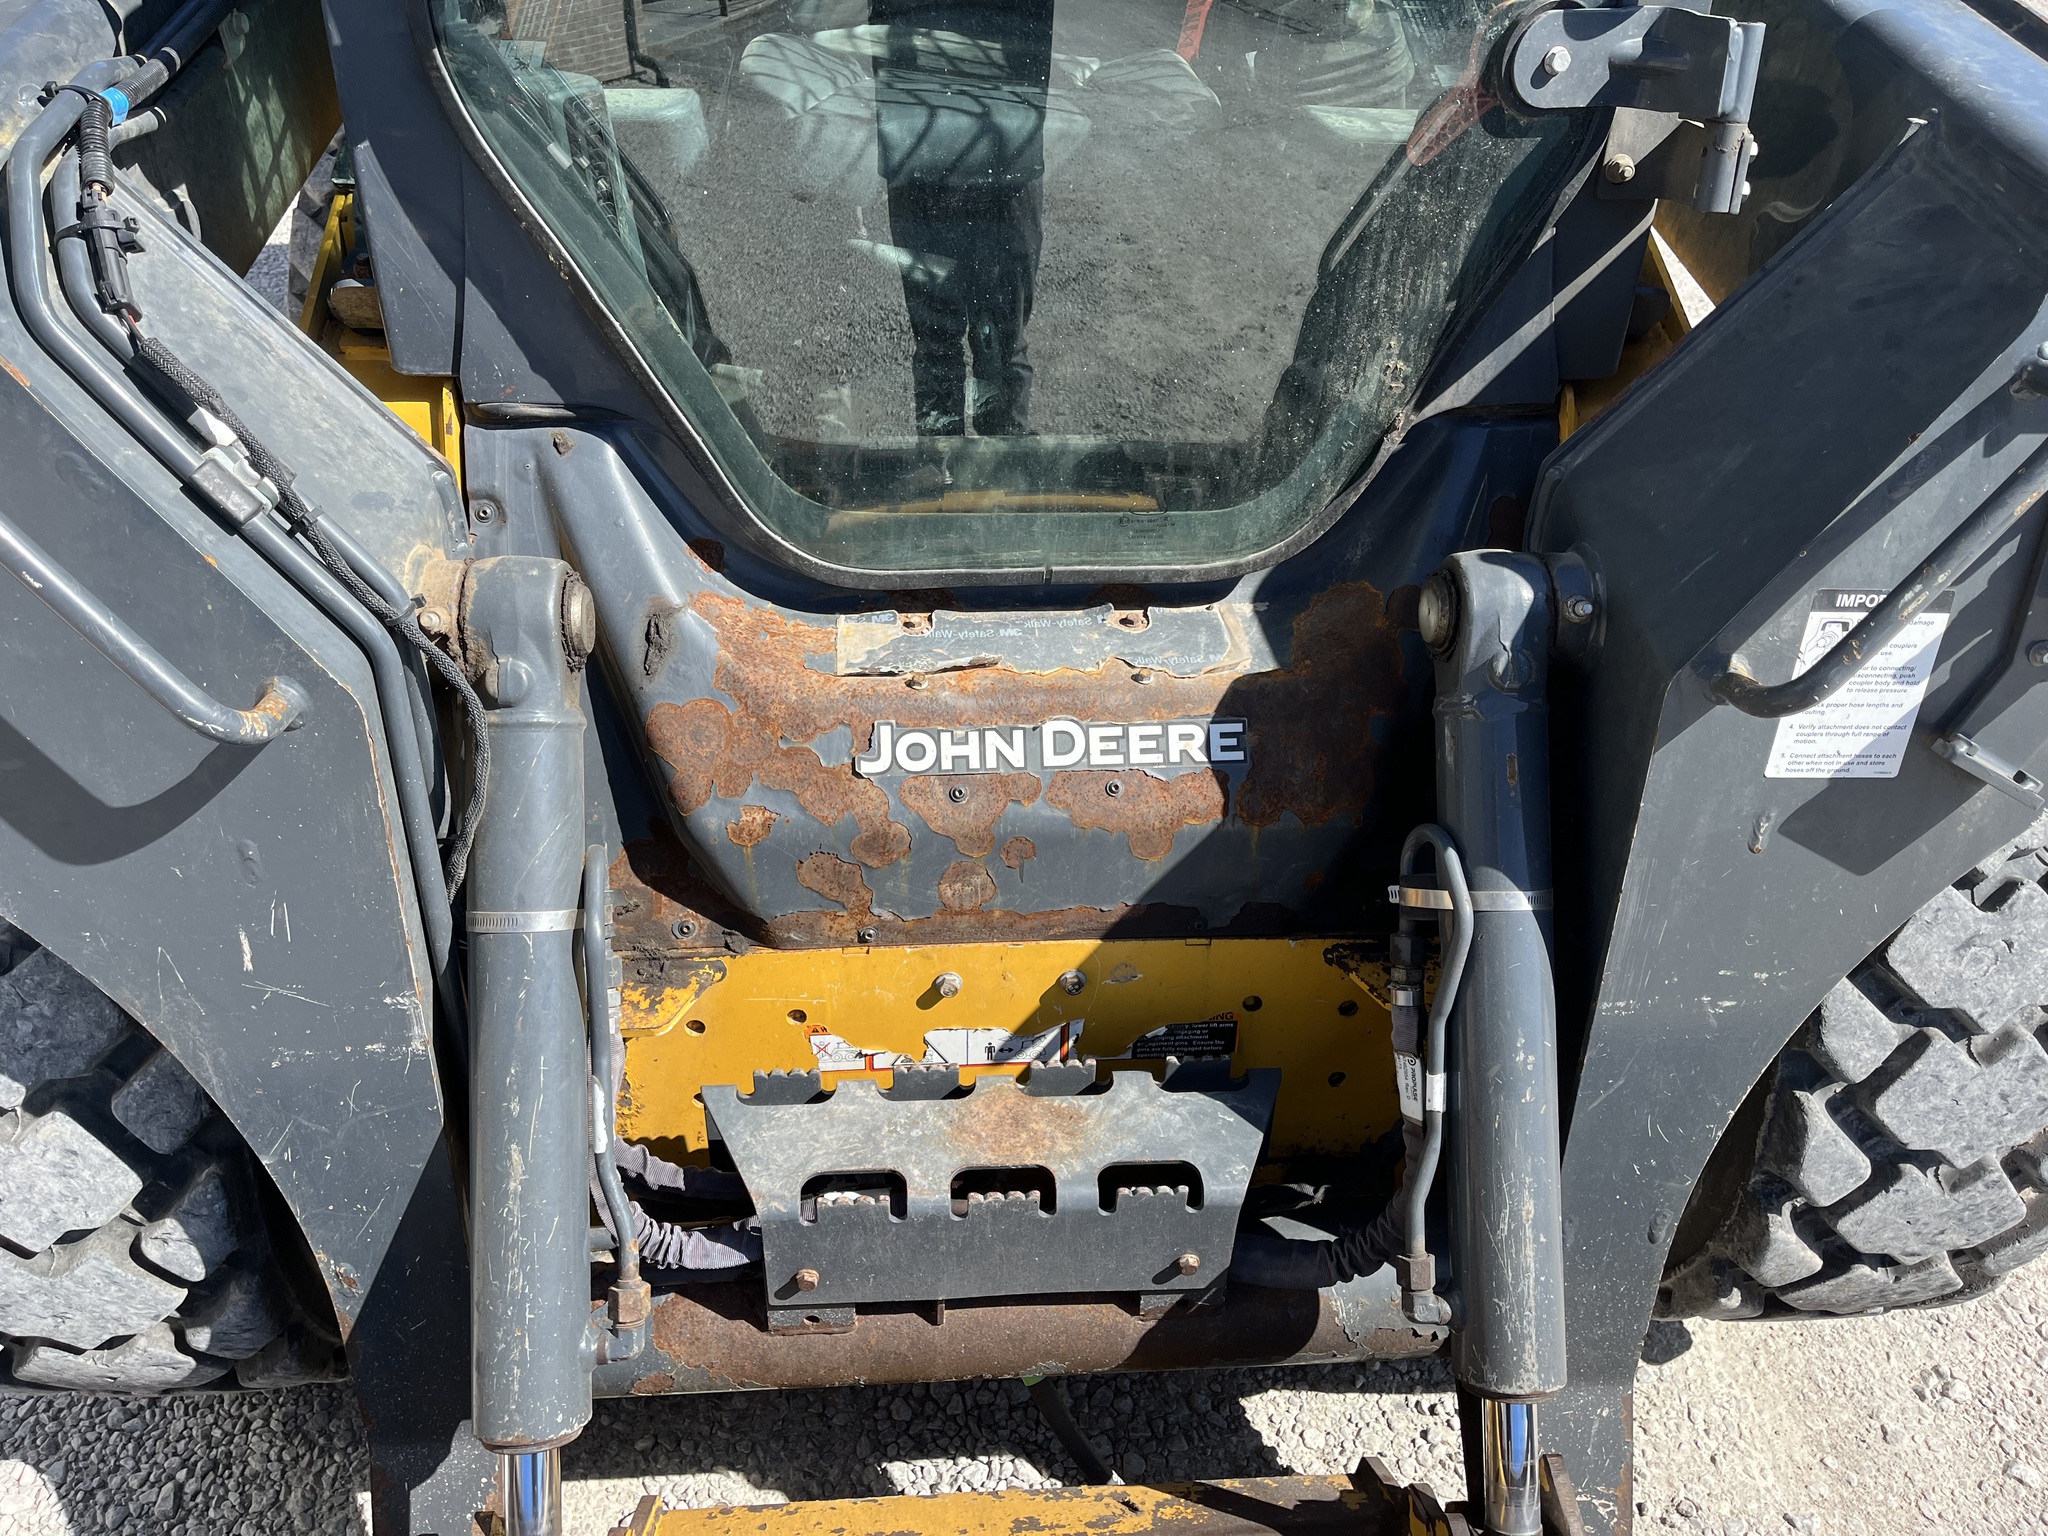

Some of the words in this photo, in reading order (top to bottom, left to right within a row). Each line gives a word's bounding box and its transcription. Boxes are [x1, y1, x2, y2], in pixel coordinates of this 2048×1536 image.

[1889, 642, 1918, 650] couplers
[859, 720, 1026, 775] JOHN
[1041, 719, 1246, 768] DEERE
